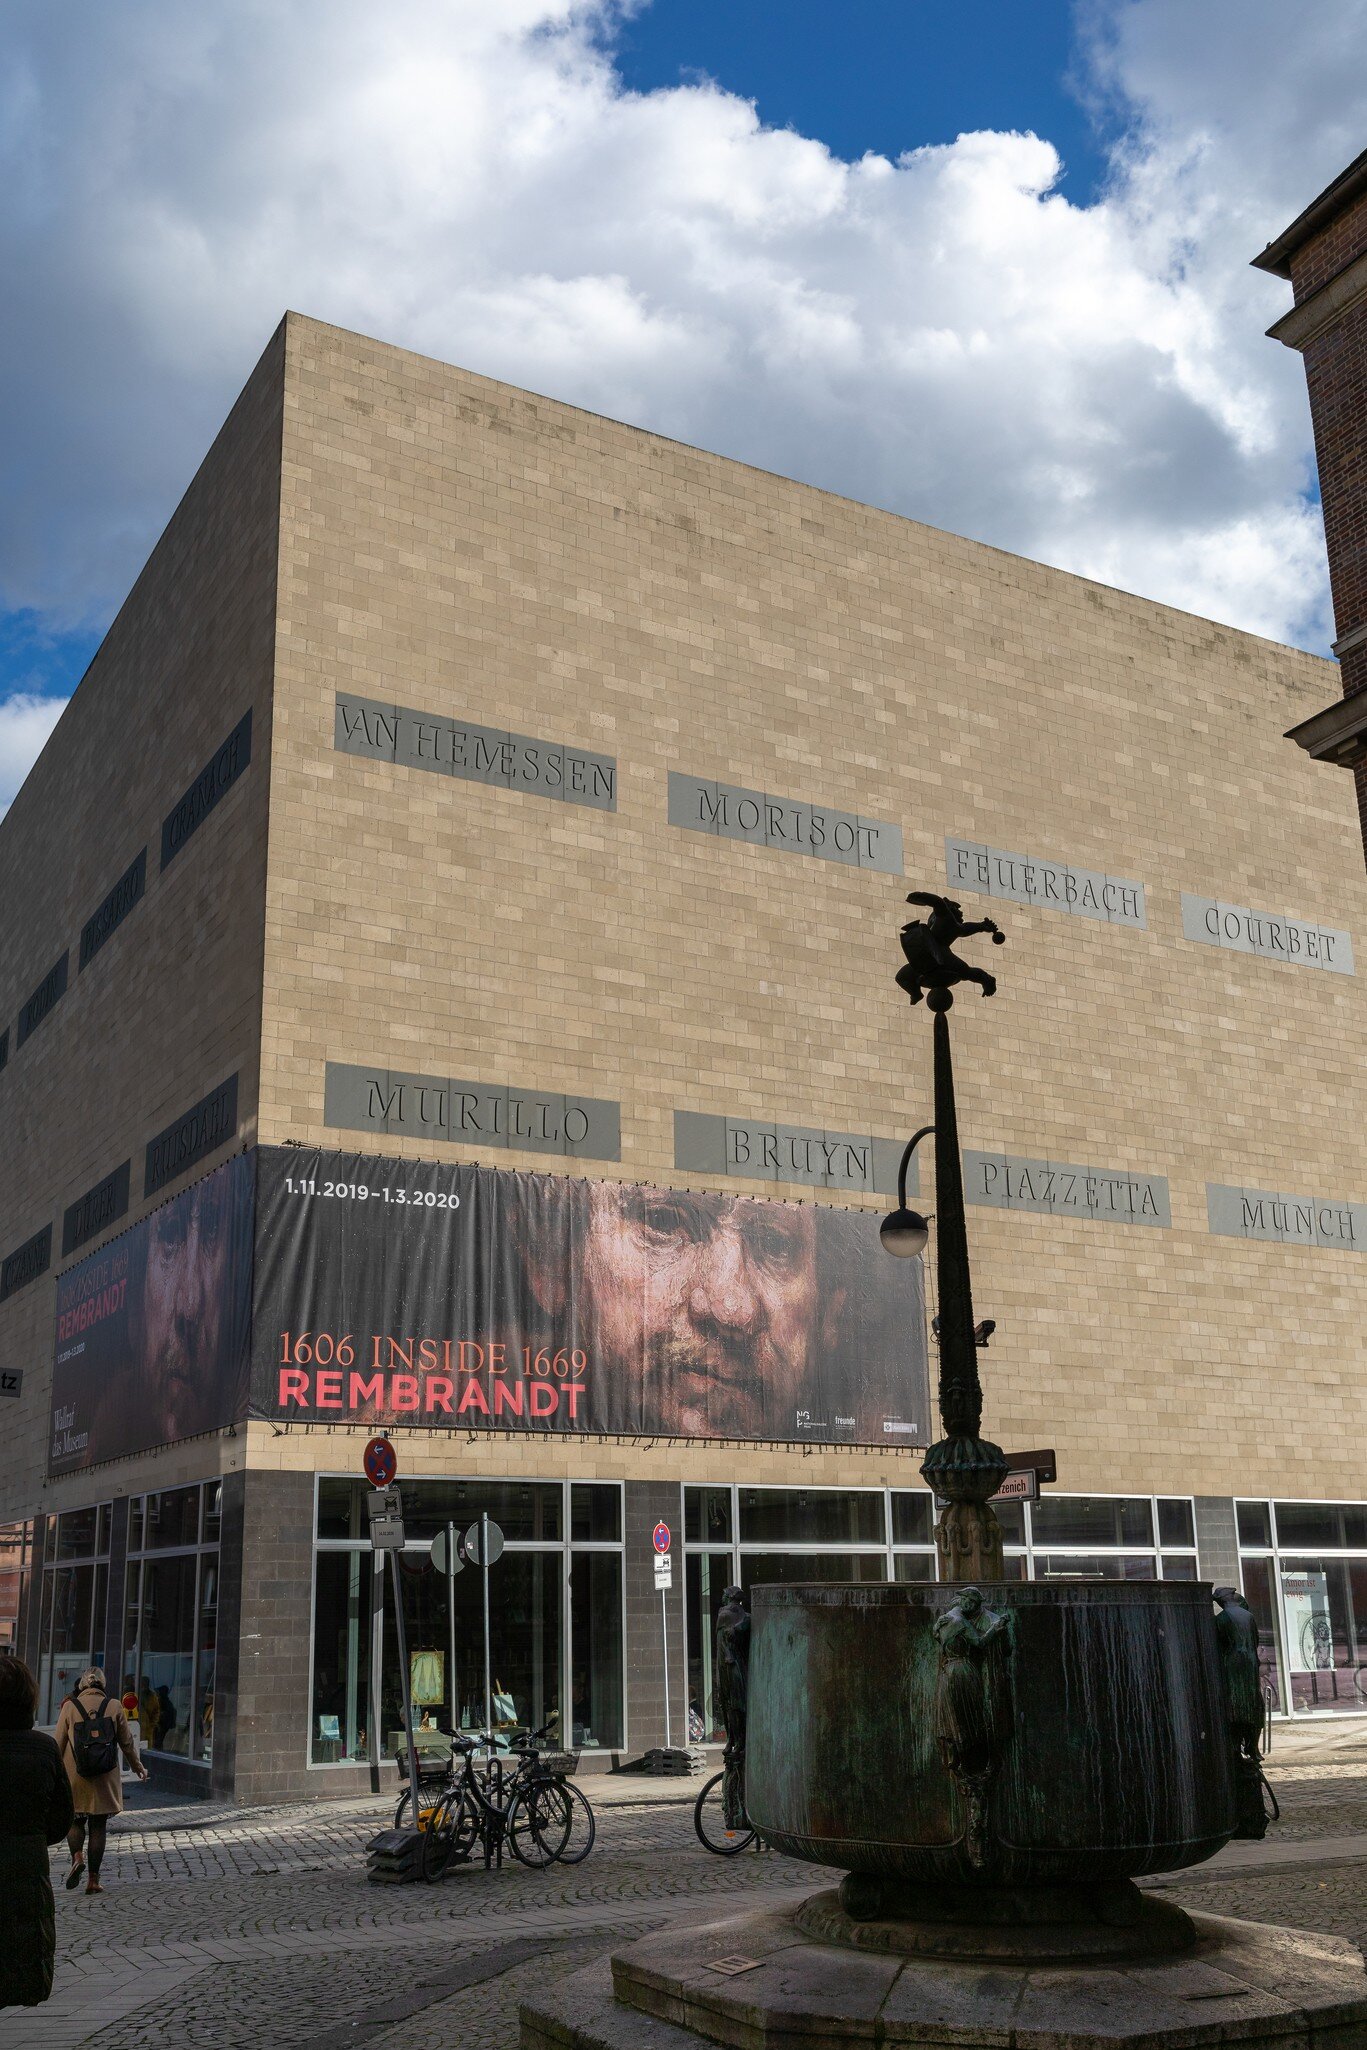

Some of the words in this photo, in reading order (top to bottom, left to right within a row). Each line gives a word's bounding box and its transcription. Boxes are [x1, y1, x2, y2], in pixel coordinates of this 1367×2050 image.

[337, 702, 401, 750] VAN
[411, 721, 616, 799] HEMESSEN
[168, 731, 242, 849] CRANACH
[696, 788, 880, 859] MORISOT
[952, 846, 1142, 919] FEUERBACH
[83, 865, 139, 959] PISSARRO
[1204, 906, 1336, 963] COURBET
[365, 1079, 590, 1144] MURILLO
[728, 1128, 870, 1180] BRUYN
[74, 1182, 114, 1240] DÜRER
[979, 1161, 1160, 1216] PIAZZETTA
[1239, 1196, 1358, 1241] MUNCH
[77, 1260, 109, 1302] INSIDE
[58, 1278, 127, 1342] REMBRANDT
[279, 1331, 356, 1368] 1606
[370, 1335, 509, 1376] INSIDE
[522, 1346, 588, 1379] 1669
[54, 1402, 76, 1433] Wallraf
[278, 1369, 587, 1419] REMBRANDT
[51, 1434, 62, 1458] das
[62, 1430, 89, 1455] Museum
[835, 1415, 856, 1426] freunde
[997, 1479, 1026, 1494] rzenich
[1285, 1579, 1305, 1587] Amor
[1306, 1579, 1316, 1587] ist
[1285, 1588, 1304, 1601] ewig
